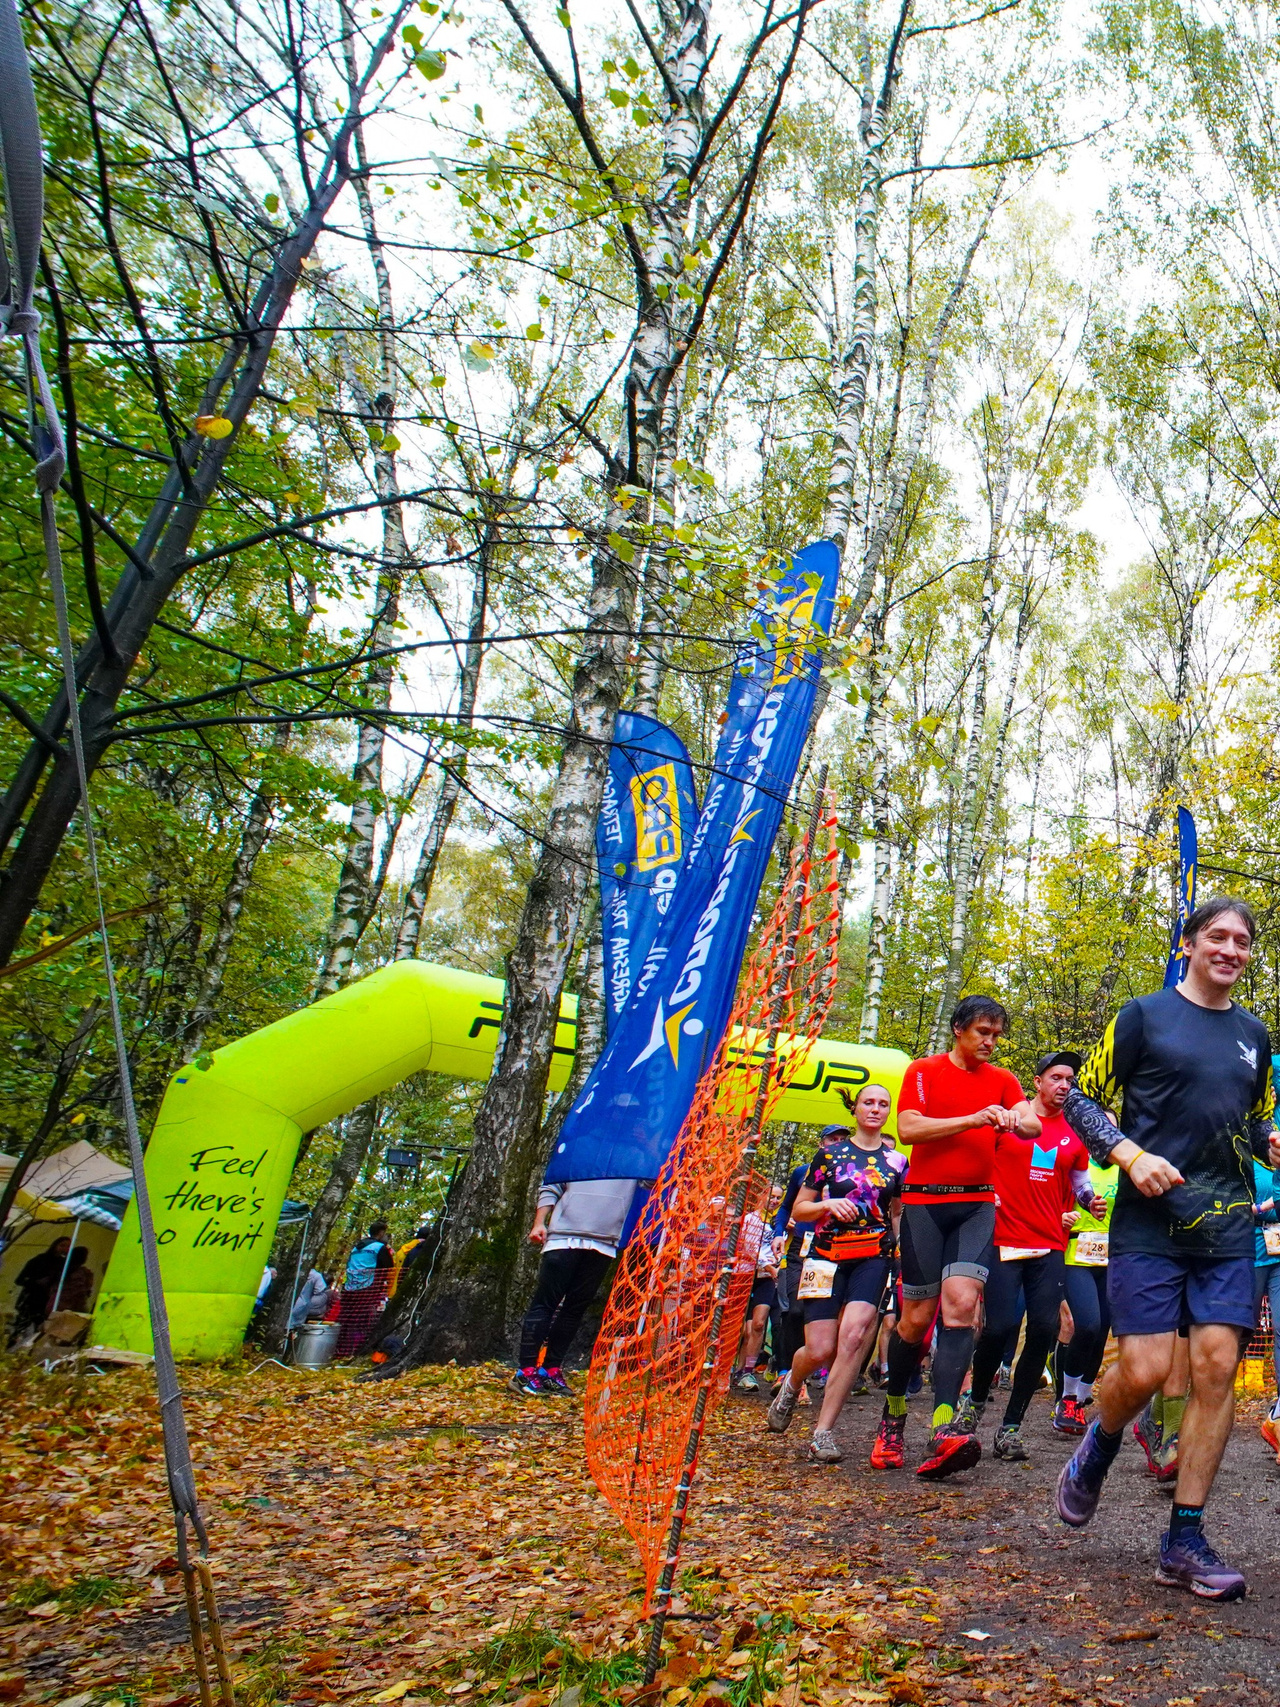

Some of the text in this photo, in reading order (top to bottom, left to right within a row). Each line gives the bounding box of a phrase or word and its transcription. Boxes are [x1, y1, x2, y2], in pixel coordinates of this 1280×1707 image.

[189, 1145, 269, 1178] Feel
[164, 1180, 265, 1216] there's
[137, 1216, 265, 1252] o limit
[1091, 1242, 1104, 1253] 28
[803, 1271, 816, 1282] 40
